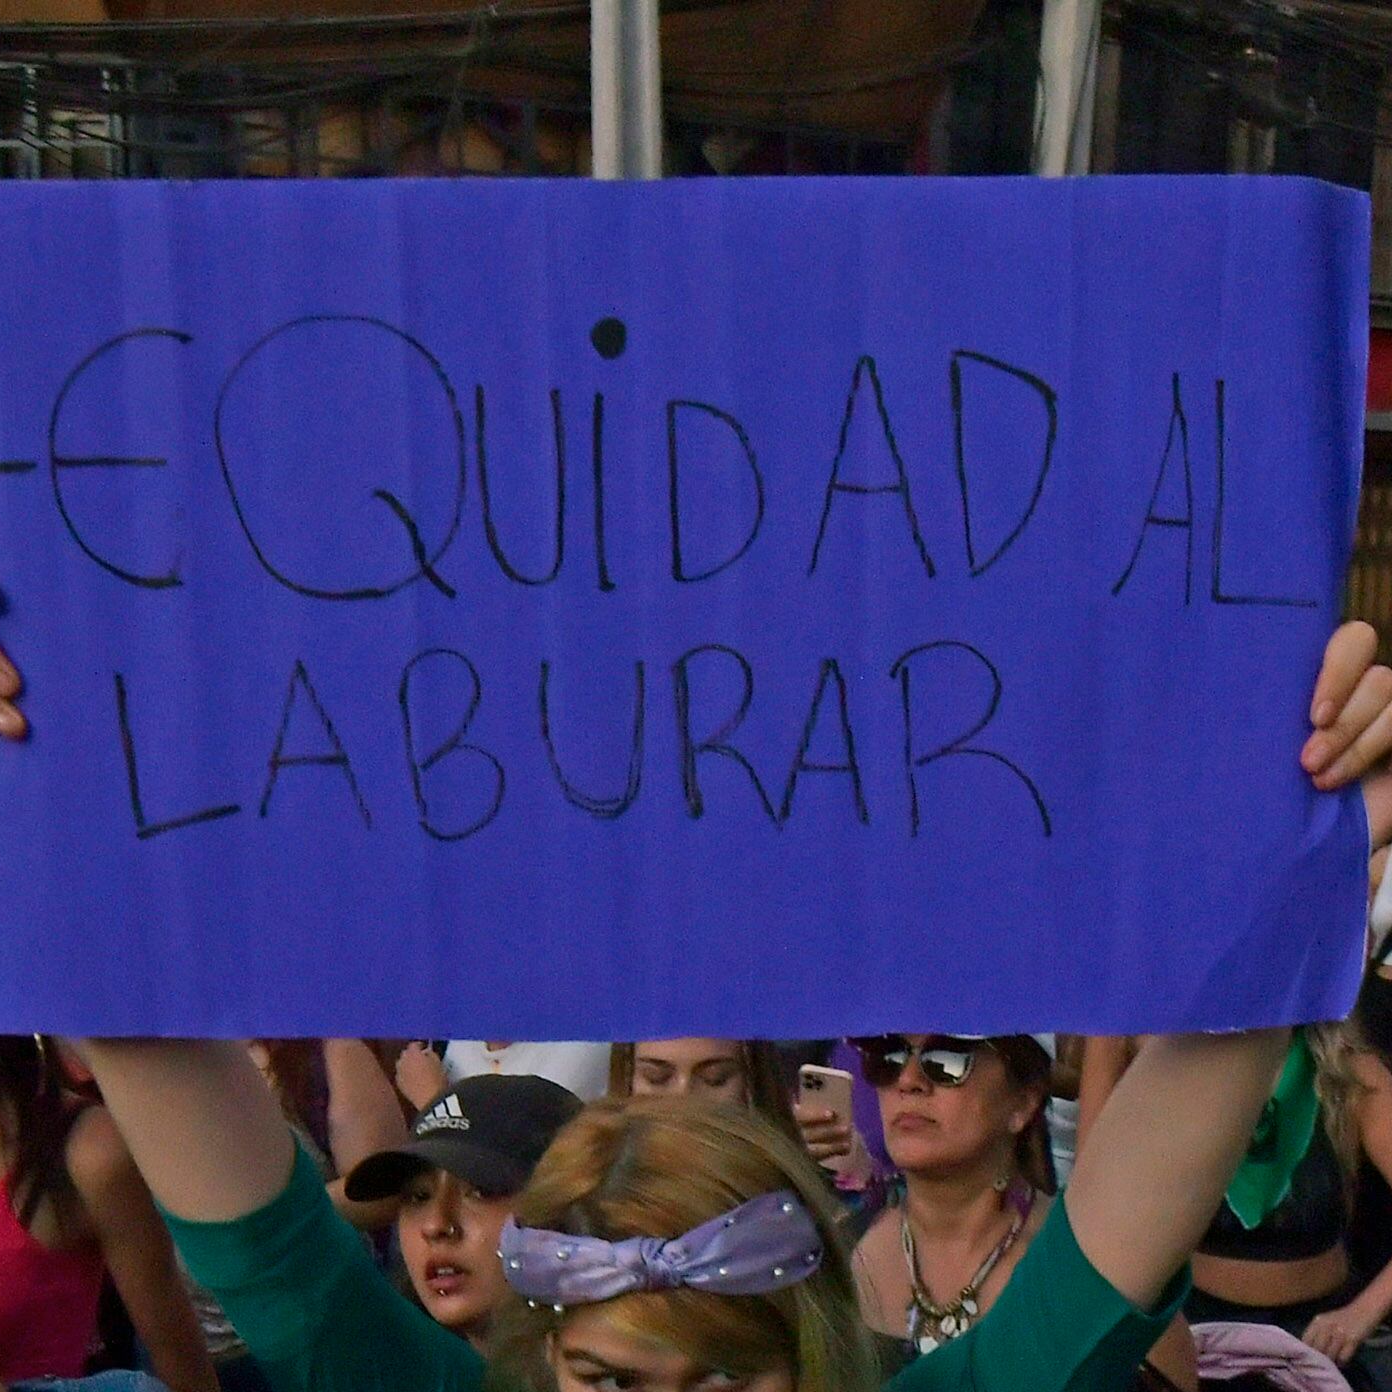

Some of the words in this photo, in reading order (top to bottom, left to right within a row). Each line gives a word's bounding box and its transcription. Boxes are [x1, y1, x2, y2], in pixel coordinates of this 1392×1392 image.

[49, 315, 1058, 600] EQUIDAD
[1112, 372, 1319, 606] AL
[114, 642, 1052, 840] LABURAR
